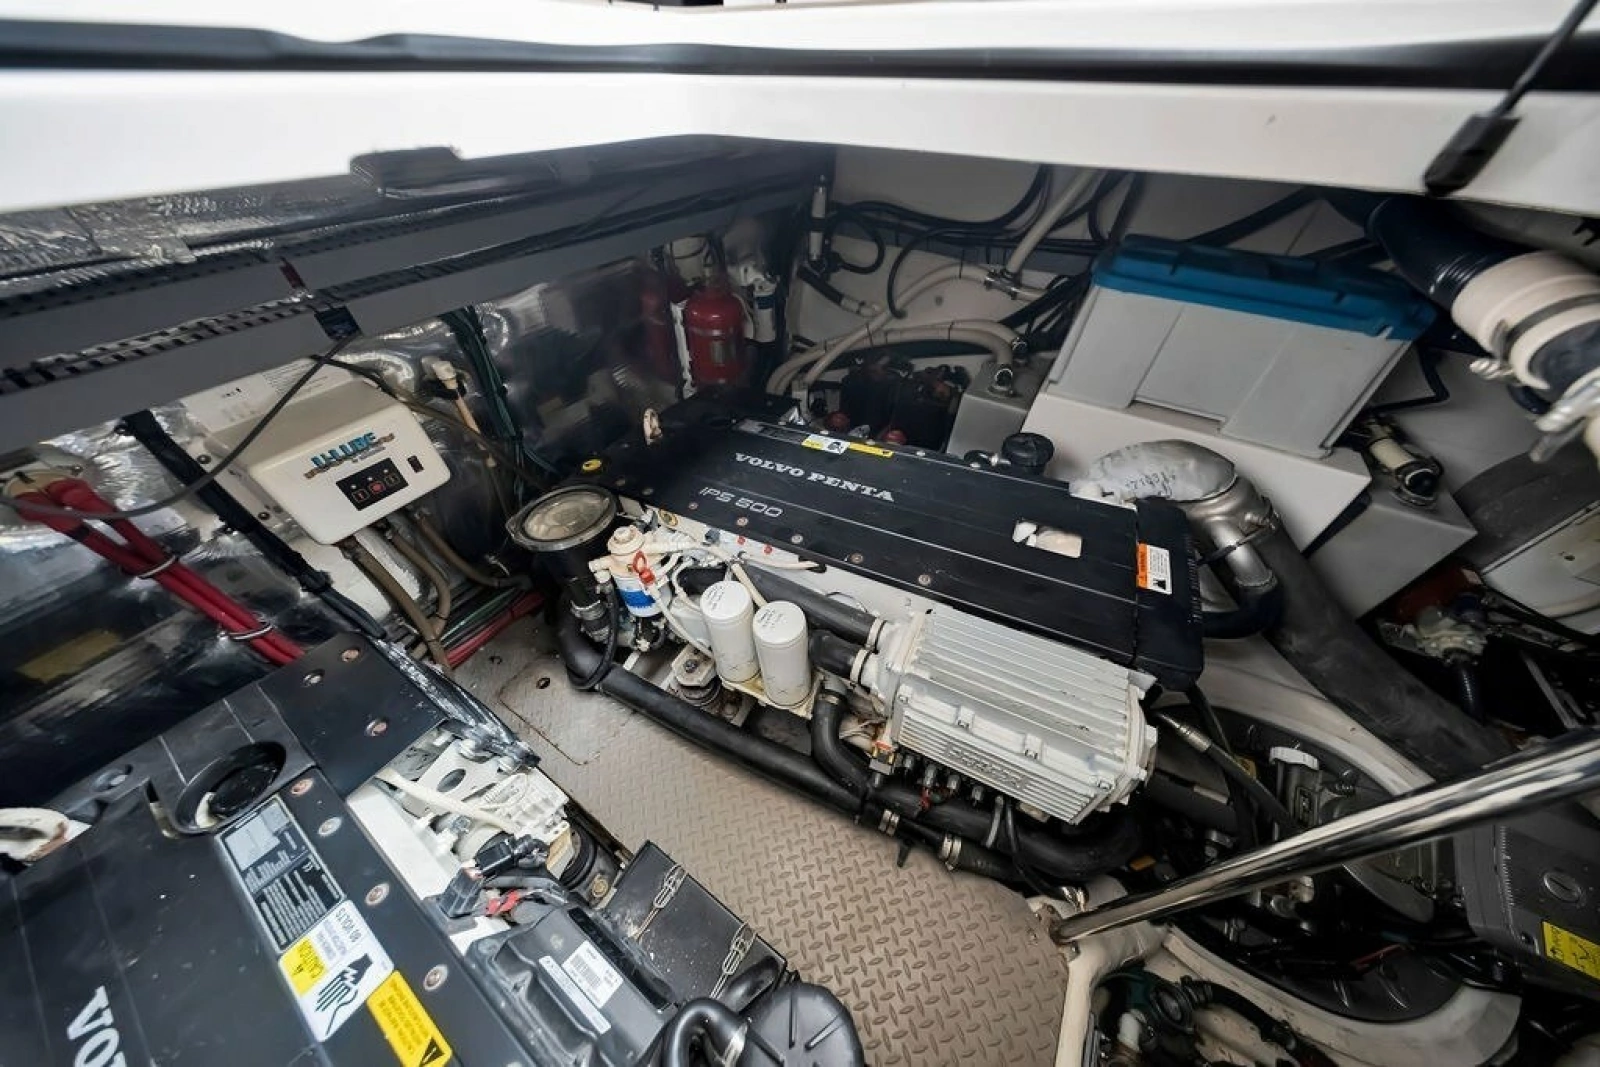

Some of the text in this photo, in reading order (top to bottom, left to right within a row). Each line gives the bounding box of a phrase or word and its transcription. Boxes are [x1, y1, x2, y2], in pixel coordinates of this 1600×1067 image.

[735, 452, 895, 502] VOLVO PENTA
[699, 486, 736, 503] IPS
